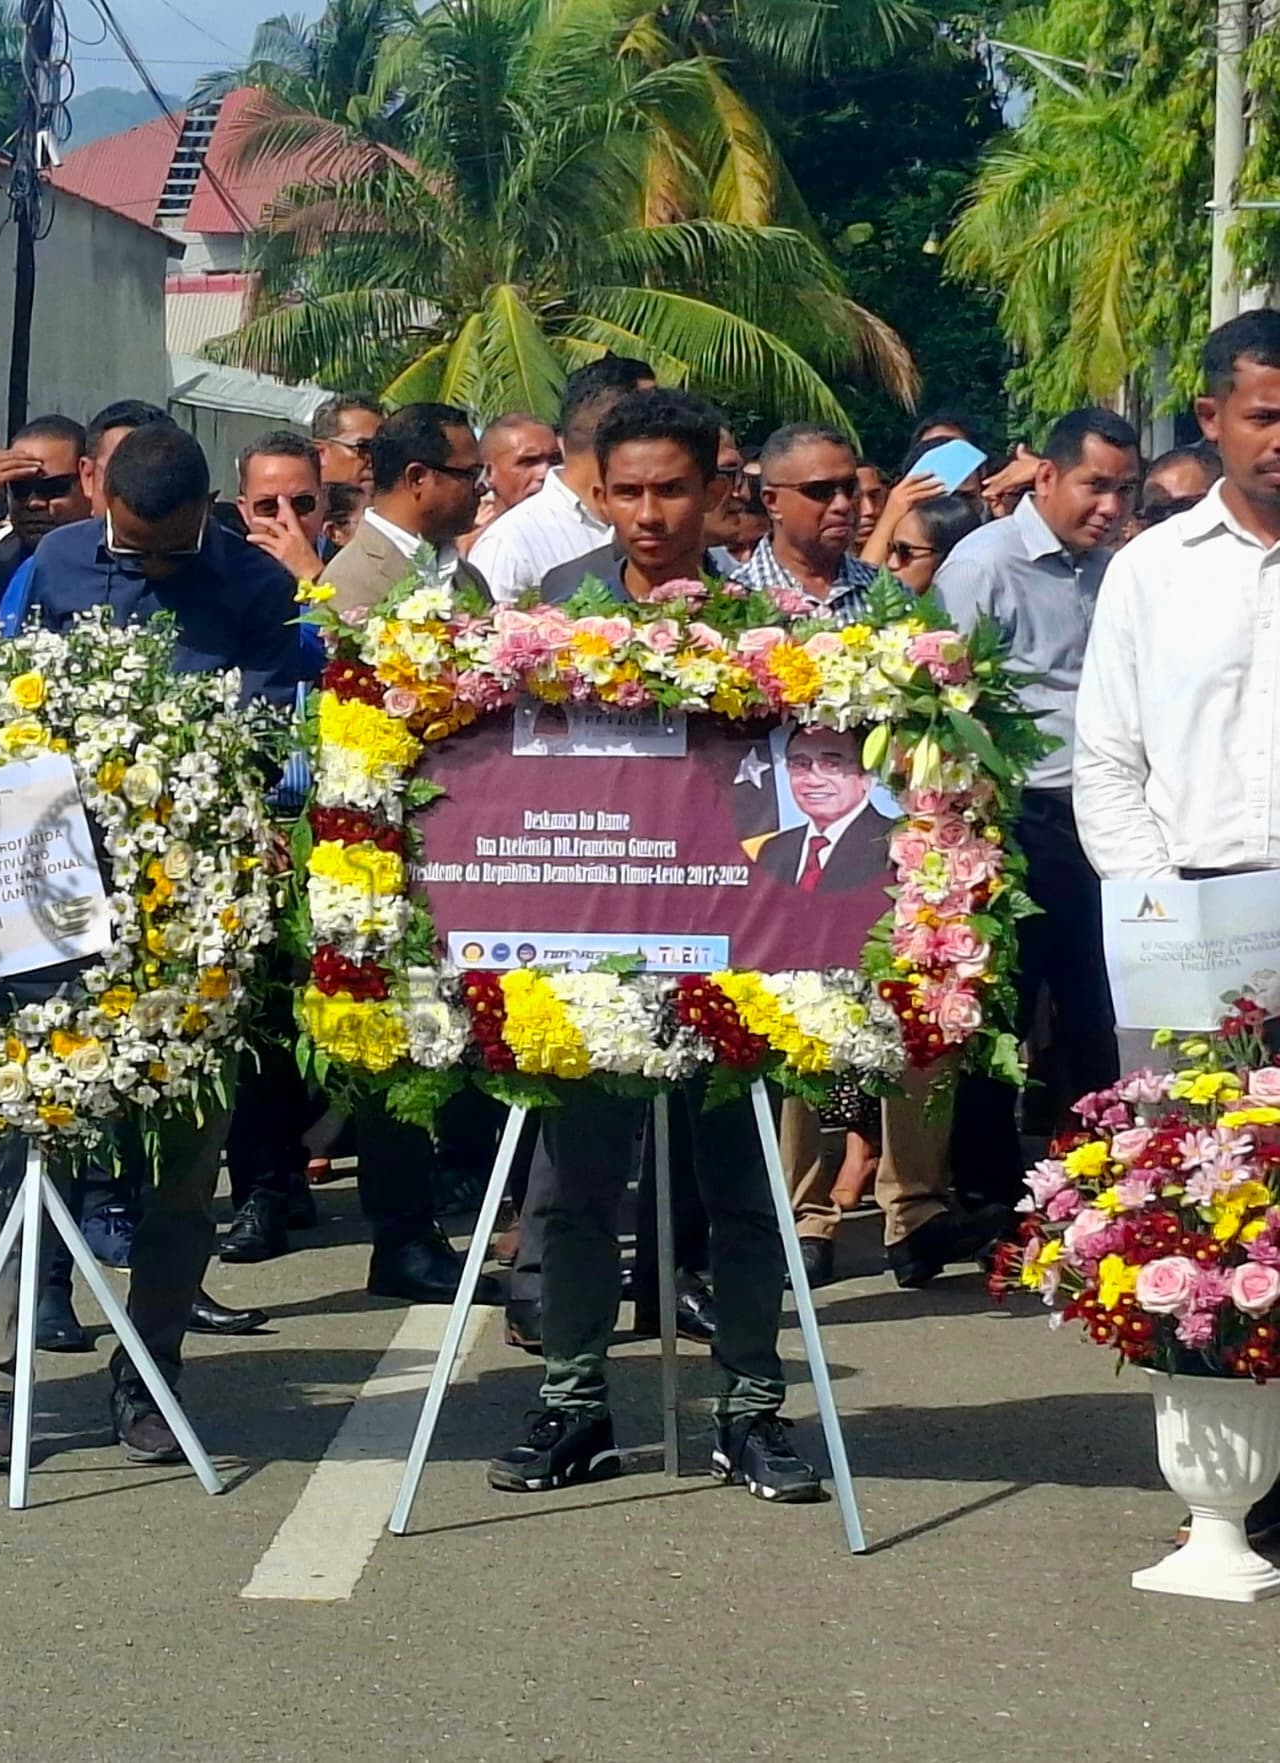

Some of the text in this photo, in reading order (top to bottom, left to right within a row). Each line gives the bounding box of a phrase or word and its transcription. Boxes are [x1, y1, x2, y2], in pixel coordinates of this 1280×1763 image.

[597, 811, 630, 831] Dame
[476, 836, 497, 856] Sua
[14, 857, 84, 882] NACIONAL
[465, 862, 480, 882] da
[686, 865, 749, 886] 2017-2022
